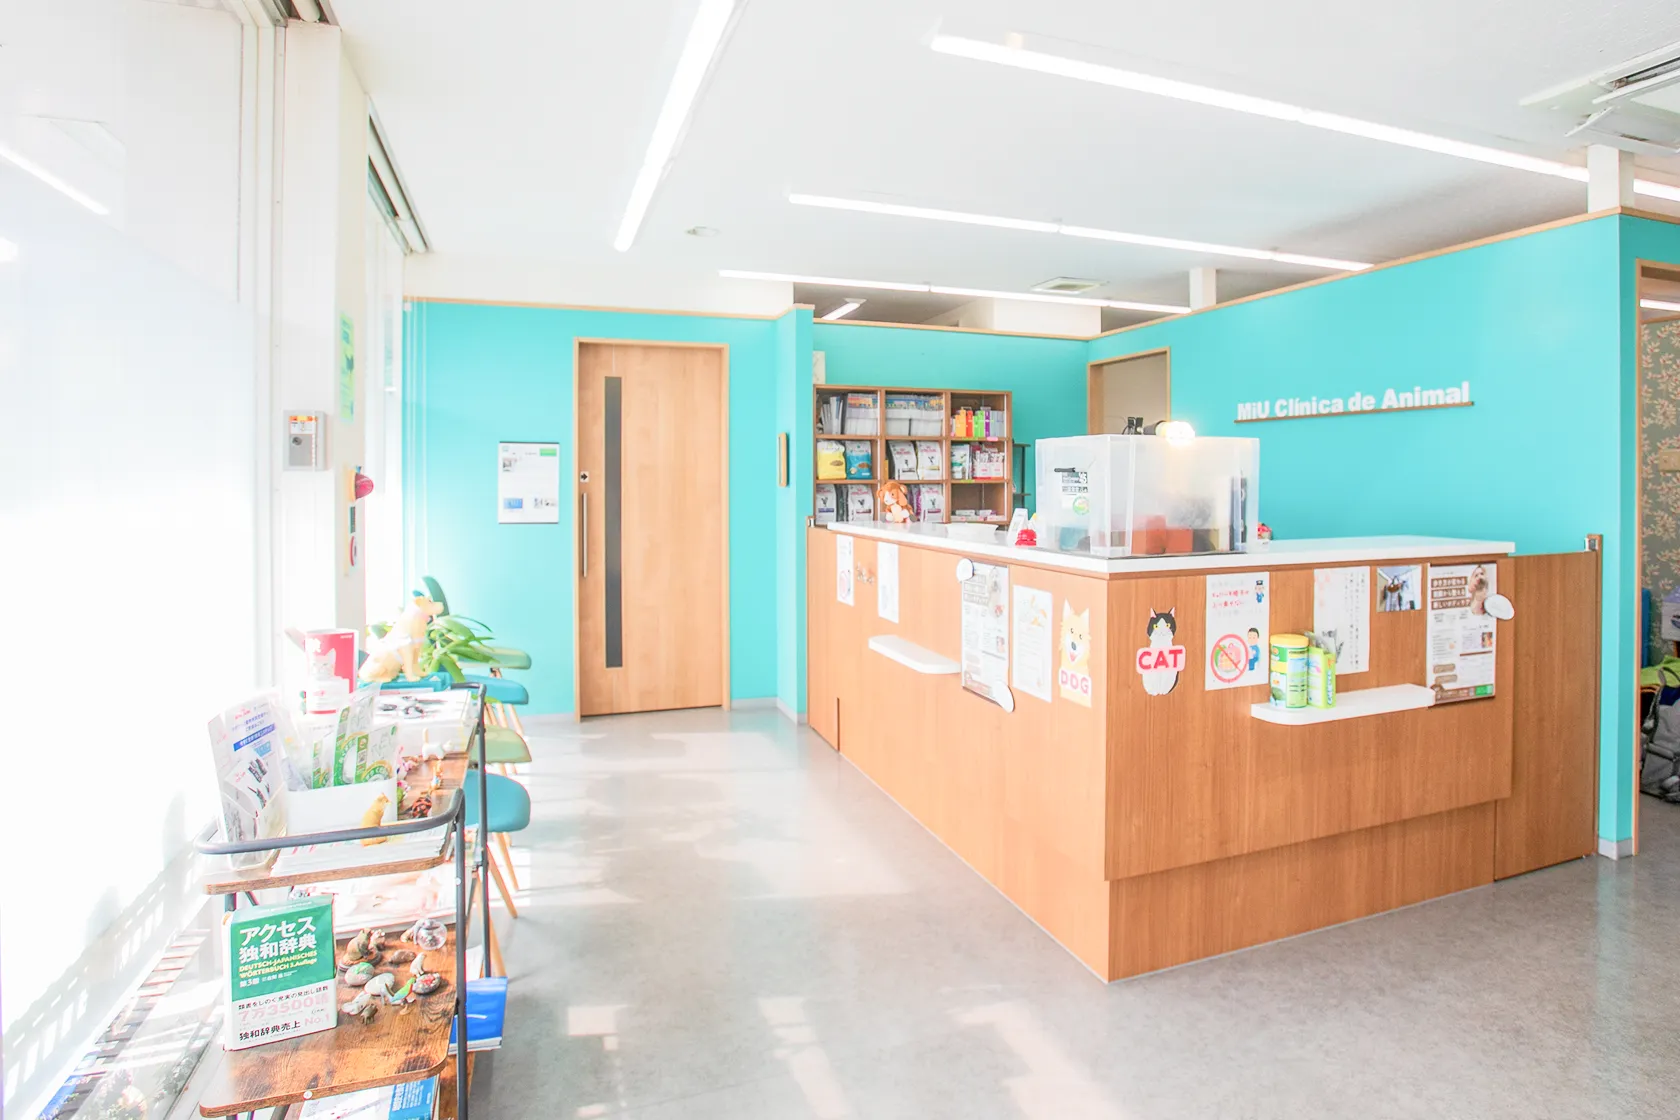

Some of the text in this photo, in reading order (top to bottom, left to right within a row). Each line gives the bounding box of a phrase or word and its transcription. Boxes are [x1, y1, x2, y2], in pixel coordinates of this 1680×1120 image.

[1237, 381, 1470, 421] MiU Clínica de Animal
[1138, 649, 1183, 669] CAT
[1061, 669, 1089, 694] DOG
[239, 916, 317, 946] アクセス
[239, 933, 317, 964] 独和辞典
[239, 1020, 301, 1041] 独和辞典売上
